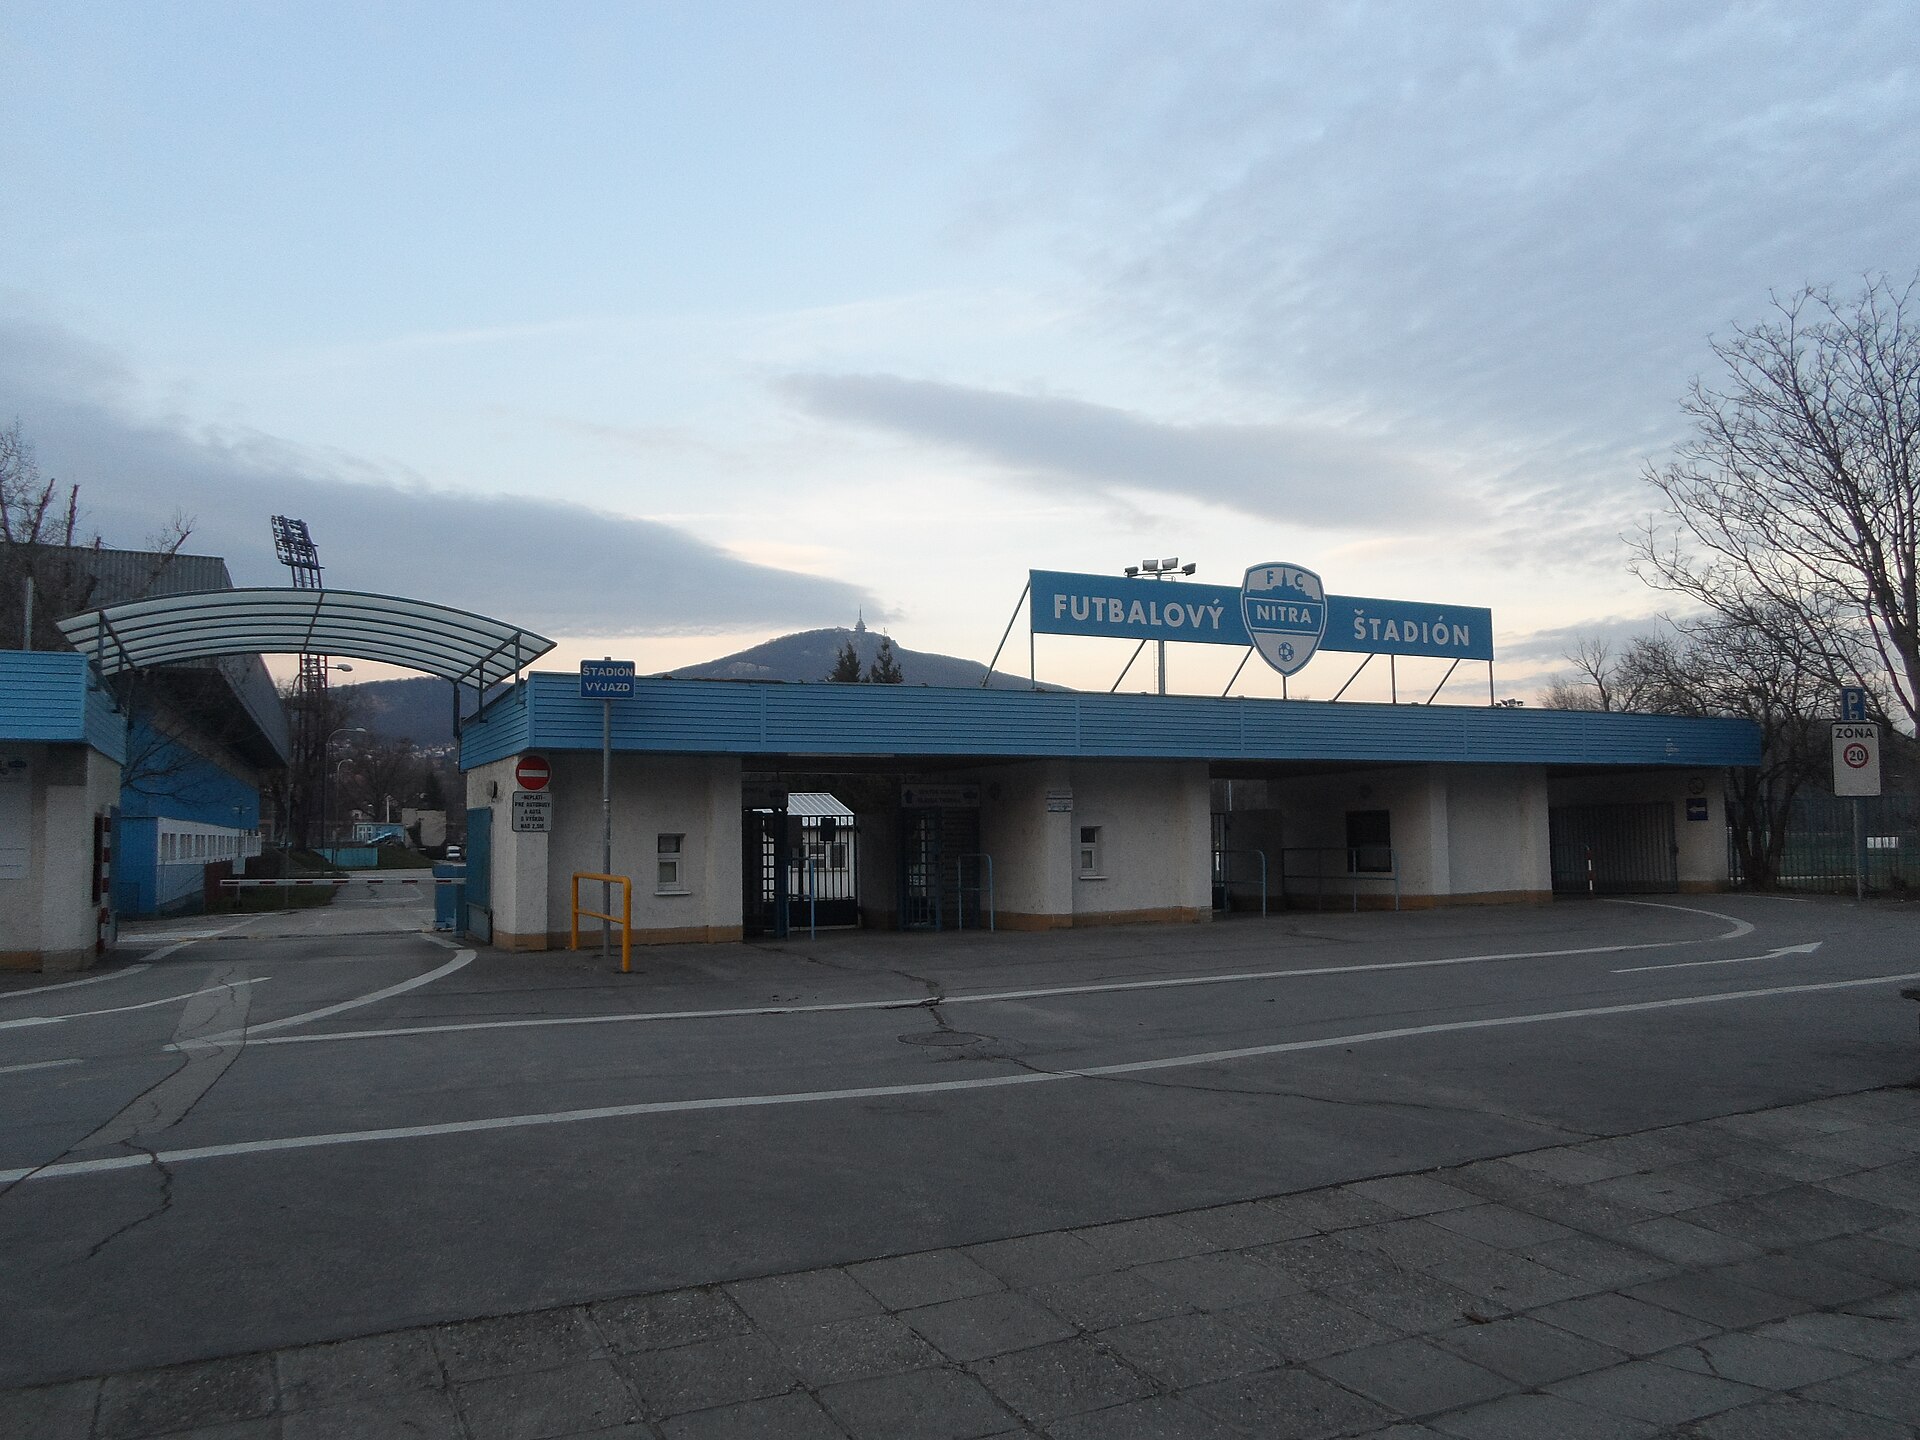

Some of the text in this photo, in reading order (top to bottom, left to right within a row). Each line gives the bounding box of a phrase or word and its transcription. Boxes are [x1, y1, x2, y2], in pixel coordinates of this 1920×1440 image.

[1053, 593, 1225, 631] FUTBALOVÝ
[1256, 604, 1312, 625] NITRA
[1353, 608, 1471, 647] ŠTADIÓN
[582, 664, 633, 676] ŠTADIÓN
[586, 680, 630, 692] VÝJAZD
[1835, 725, 1874, 739] ZÓNA
[1848, 749, 1864, 762] 20
